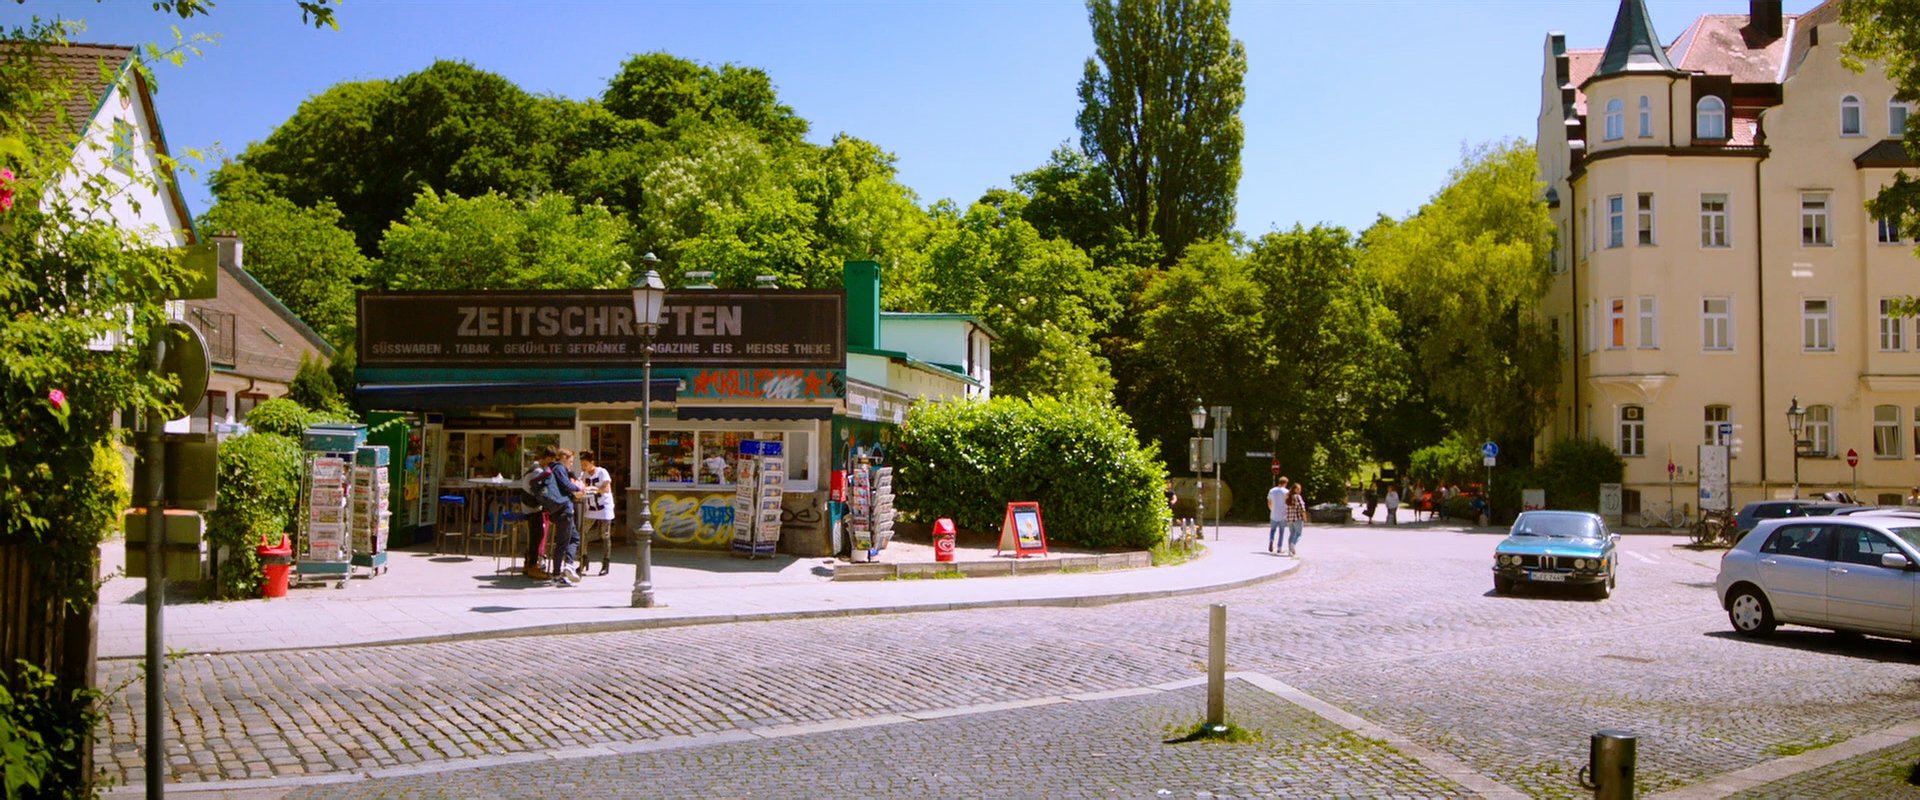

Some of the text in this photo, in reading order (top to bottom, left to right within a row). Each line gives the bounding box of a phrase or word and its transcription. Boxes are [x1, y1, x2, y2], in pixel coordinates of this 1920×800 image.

[457, 306, 742, 337] ZEITSCHRFTEN
[372, 341, 442, 355] SÜSSWAREN
[455, 343, 490, 354] TABAK
[503, 341, 562, 354] GEKÜHLTE
[567, 341, 626, 354] GETRÄNKE
[712, 343, 733, 354] EIS
[746, 343, 789, 354] HEISSE
[793, 343, 831, 354] THEKE
